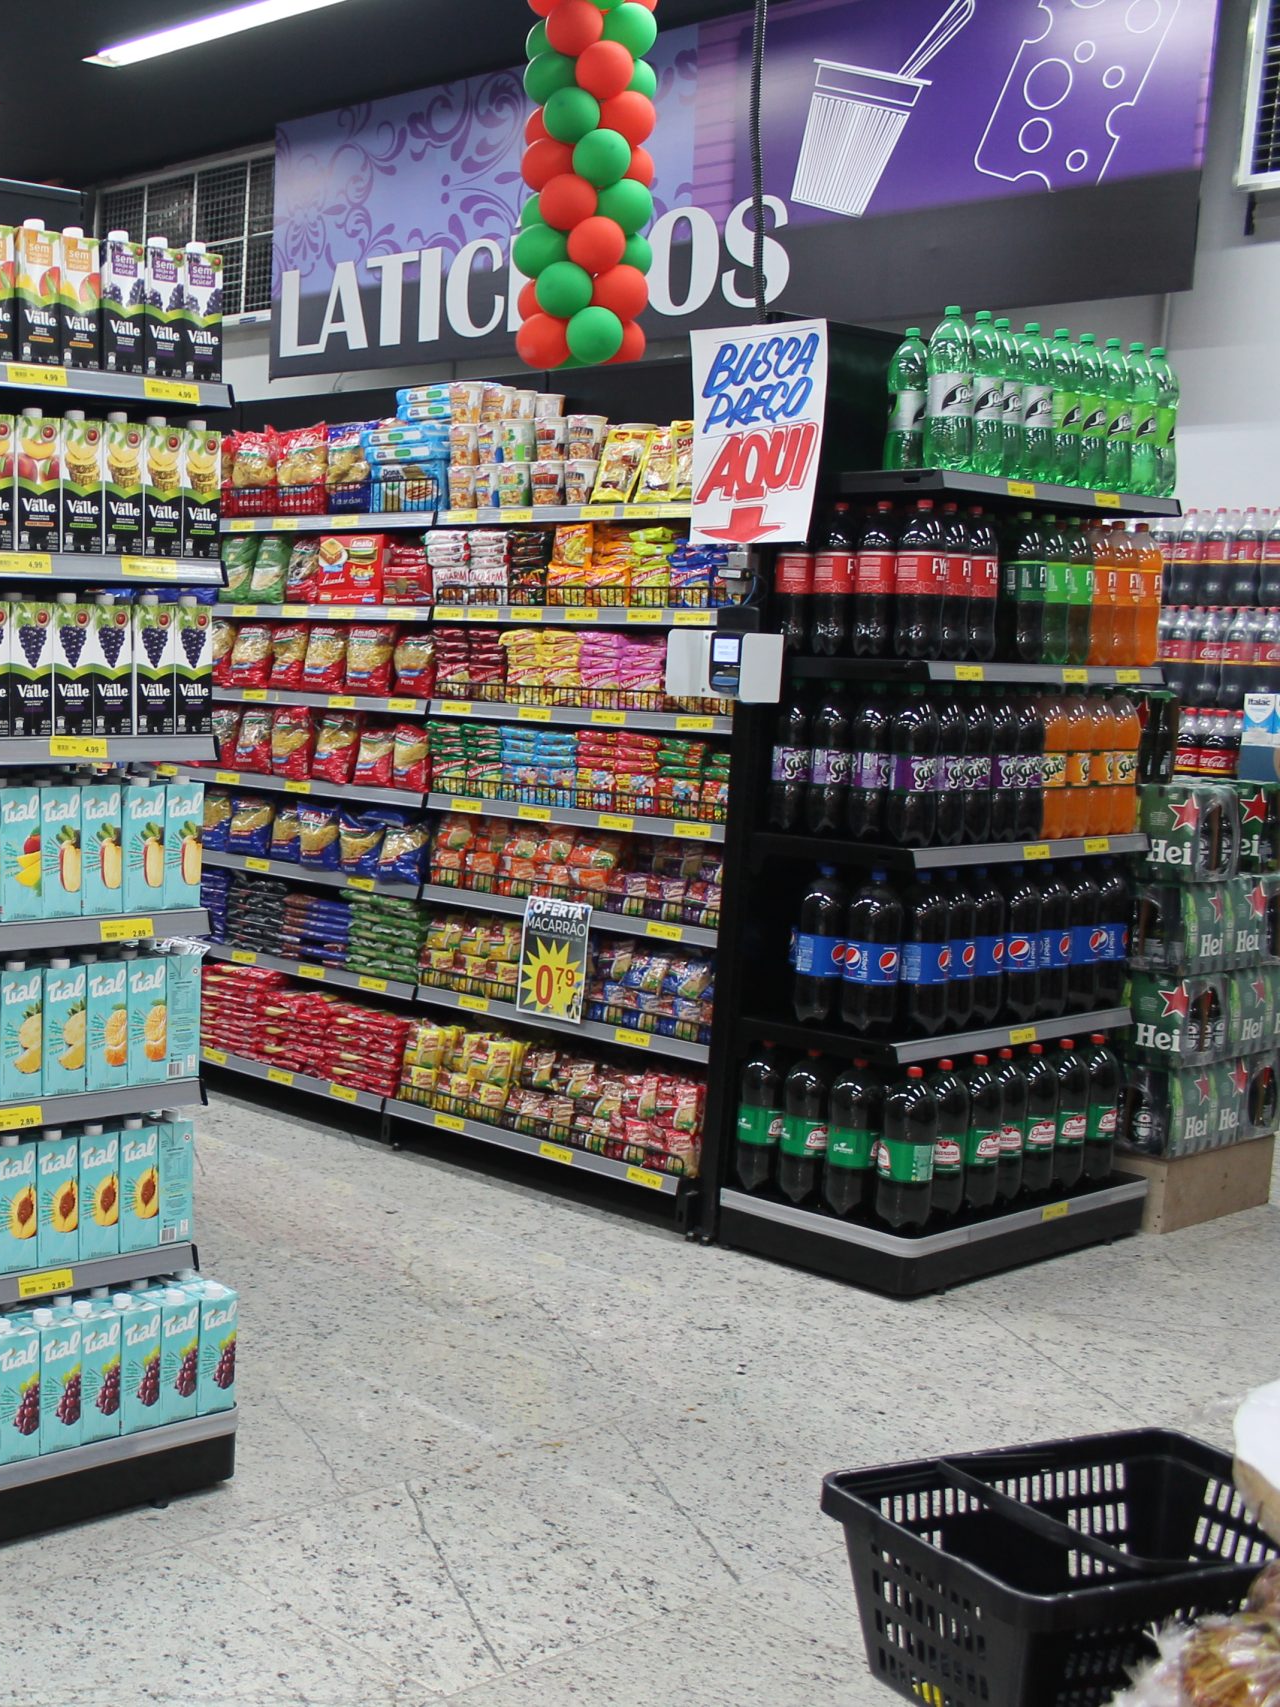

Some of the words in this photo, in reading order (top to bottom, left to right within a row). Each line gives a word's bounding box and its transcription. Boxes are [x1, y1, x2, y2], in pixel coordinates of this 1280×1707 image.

[115, 254, 135, 265] sem
[155, 260, 175, 270] sem
[192, 265, 212, 277] sem
[279, 194, 791, 358] LATICOS
[701, 332, 819, 398] BUSCA
[695, 423, 817, 503] AQUI
[533, 901, 584, 920] OFERTA
[527, 916, 586, 937] MACARRÃO
[1135, 1023, 1181, 1052] Hei
